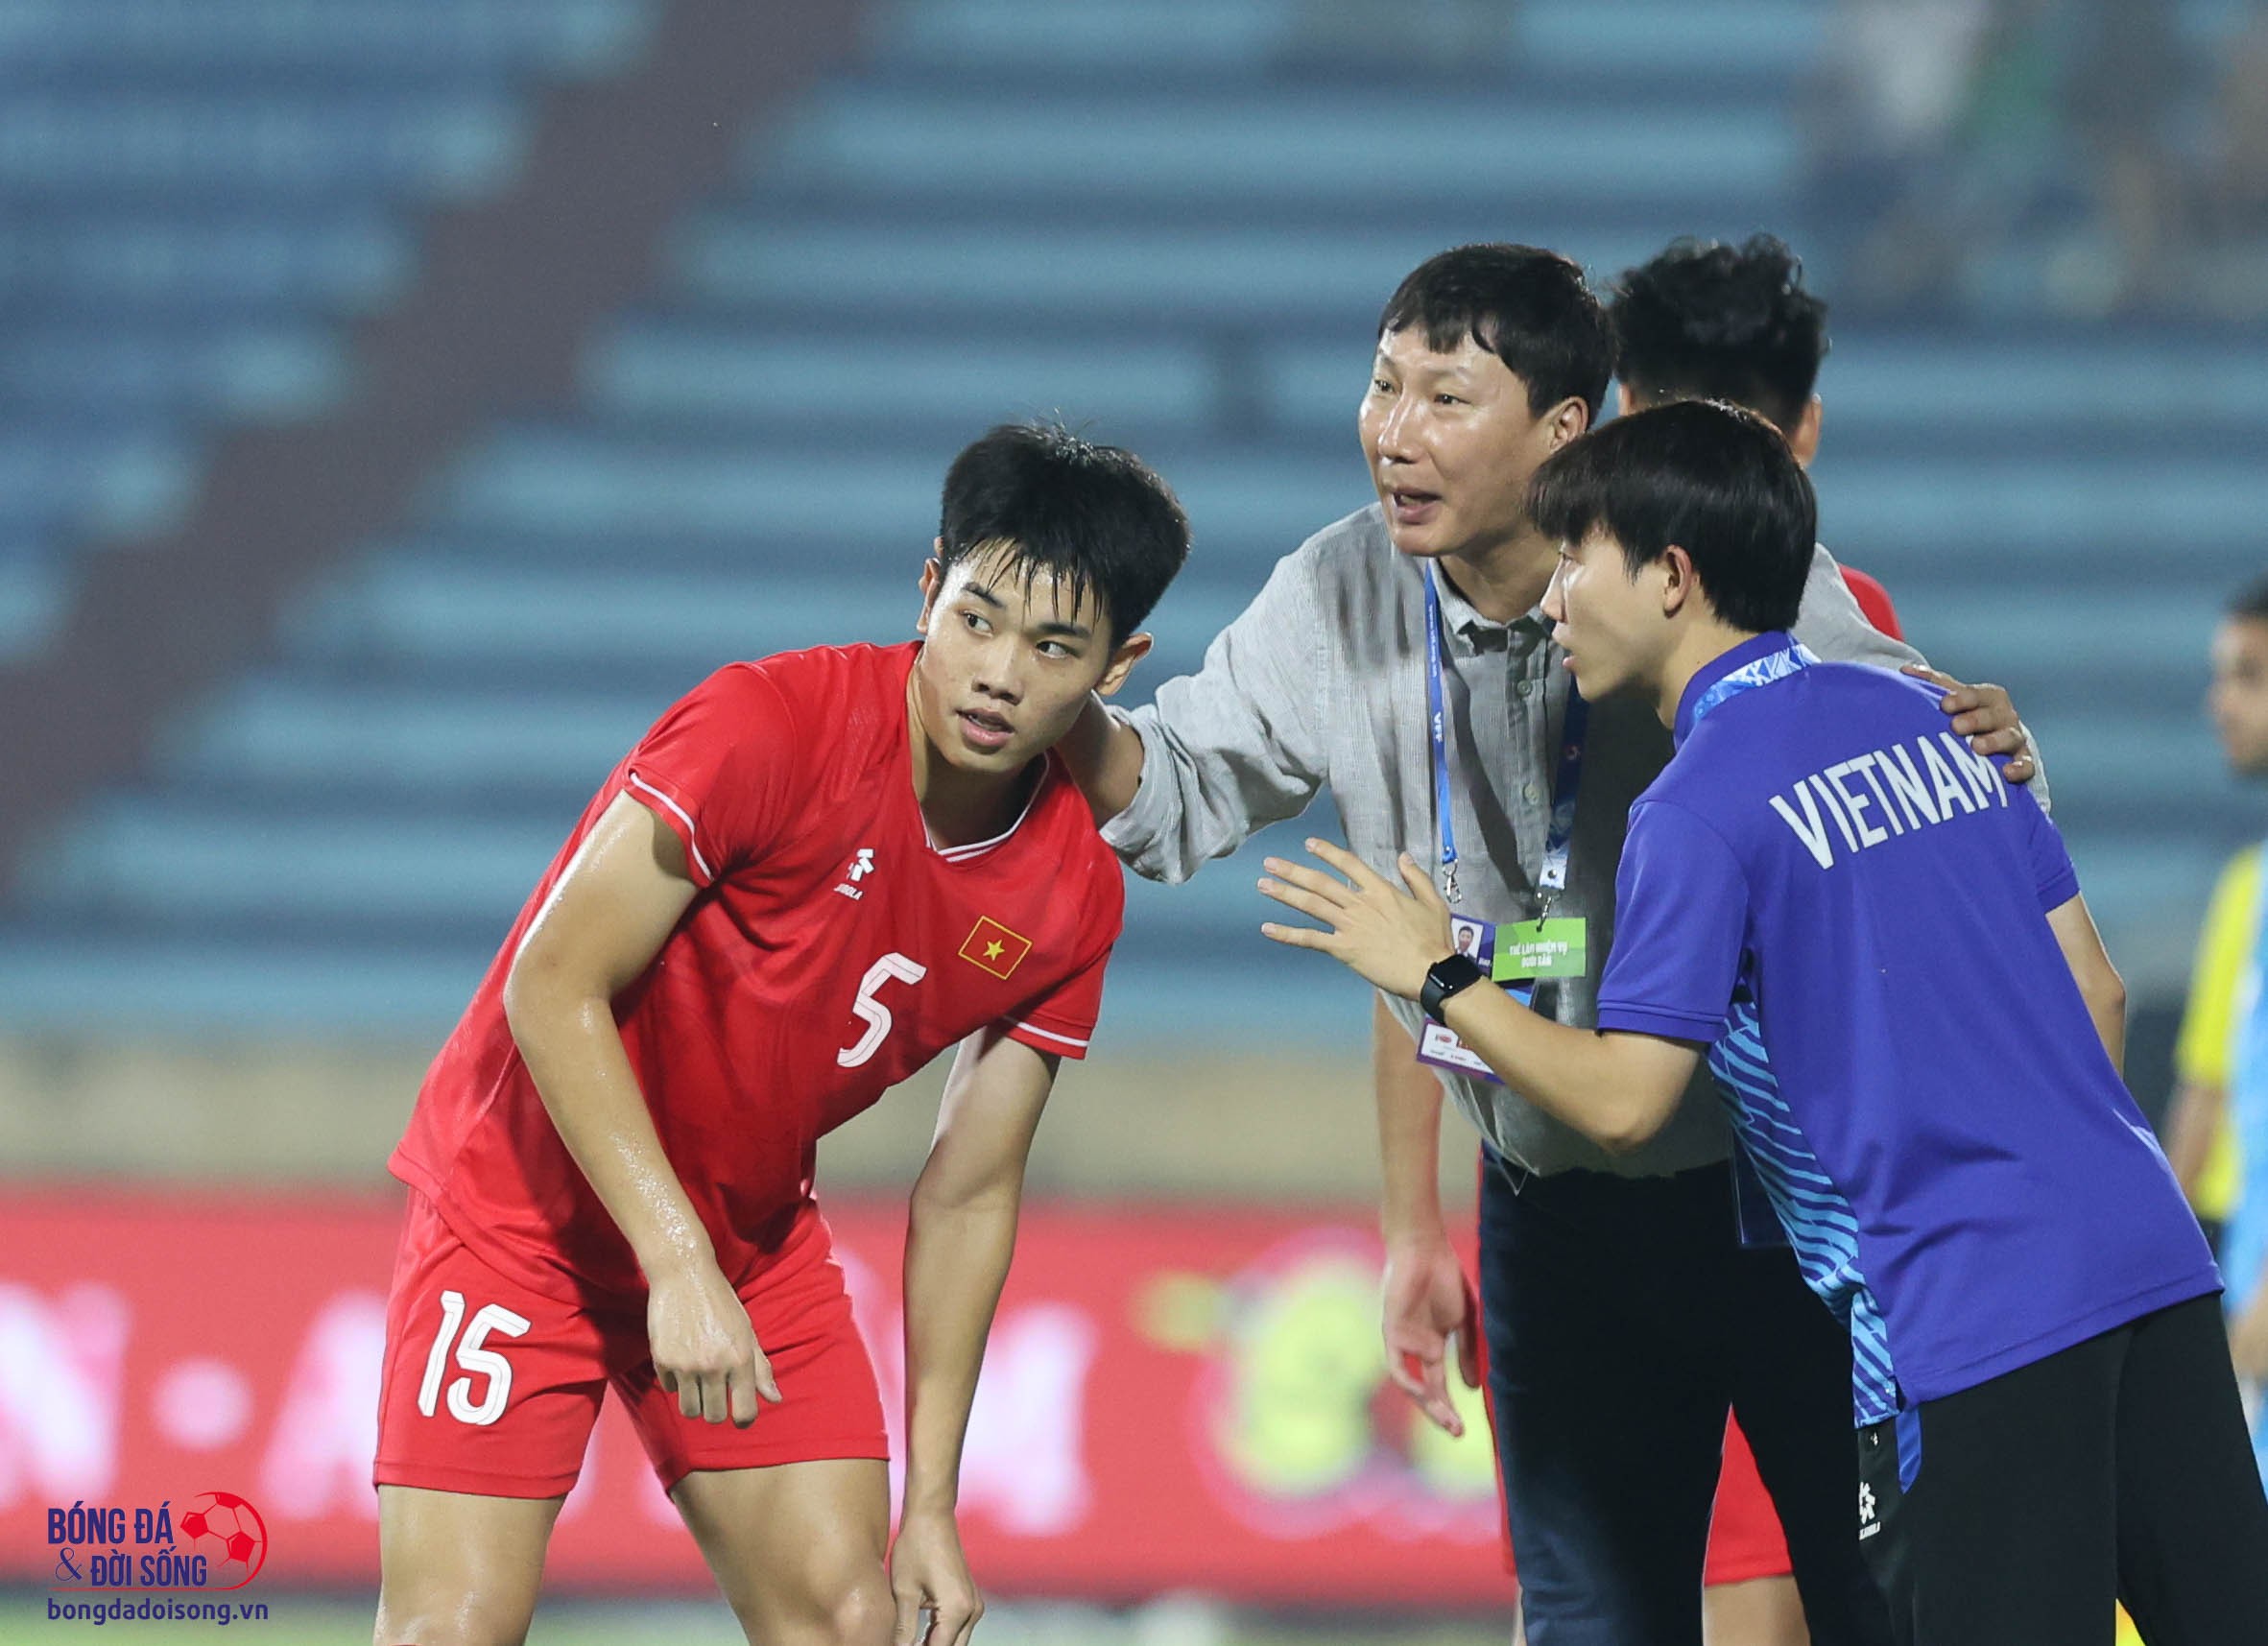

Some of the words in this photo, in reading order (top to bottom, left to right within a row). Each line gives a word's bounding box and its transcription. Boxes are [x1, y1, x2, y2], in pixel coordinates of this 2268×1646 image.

[1434, 711, 1444, 743] VFF
[1768, 731, 2009, 871] VIETNAM
[418, 1290, 532, 1426] 15
